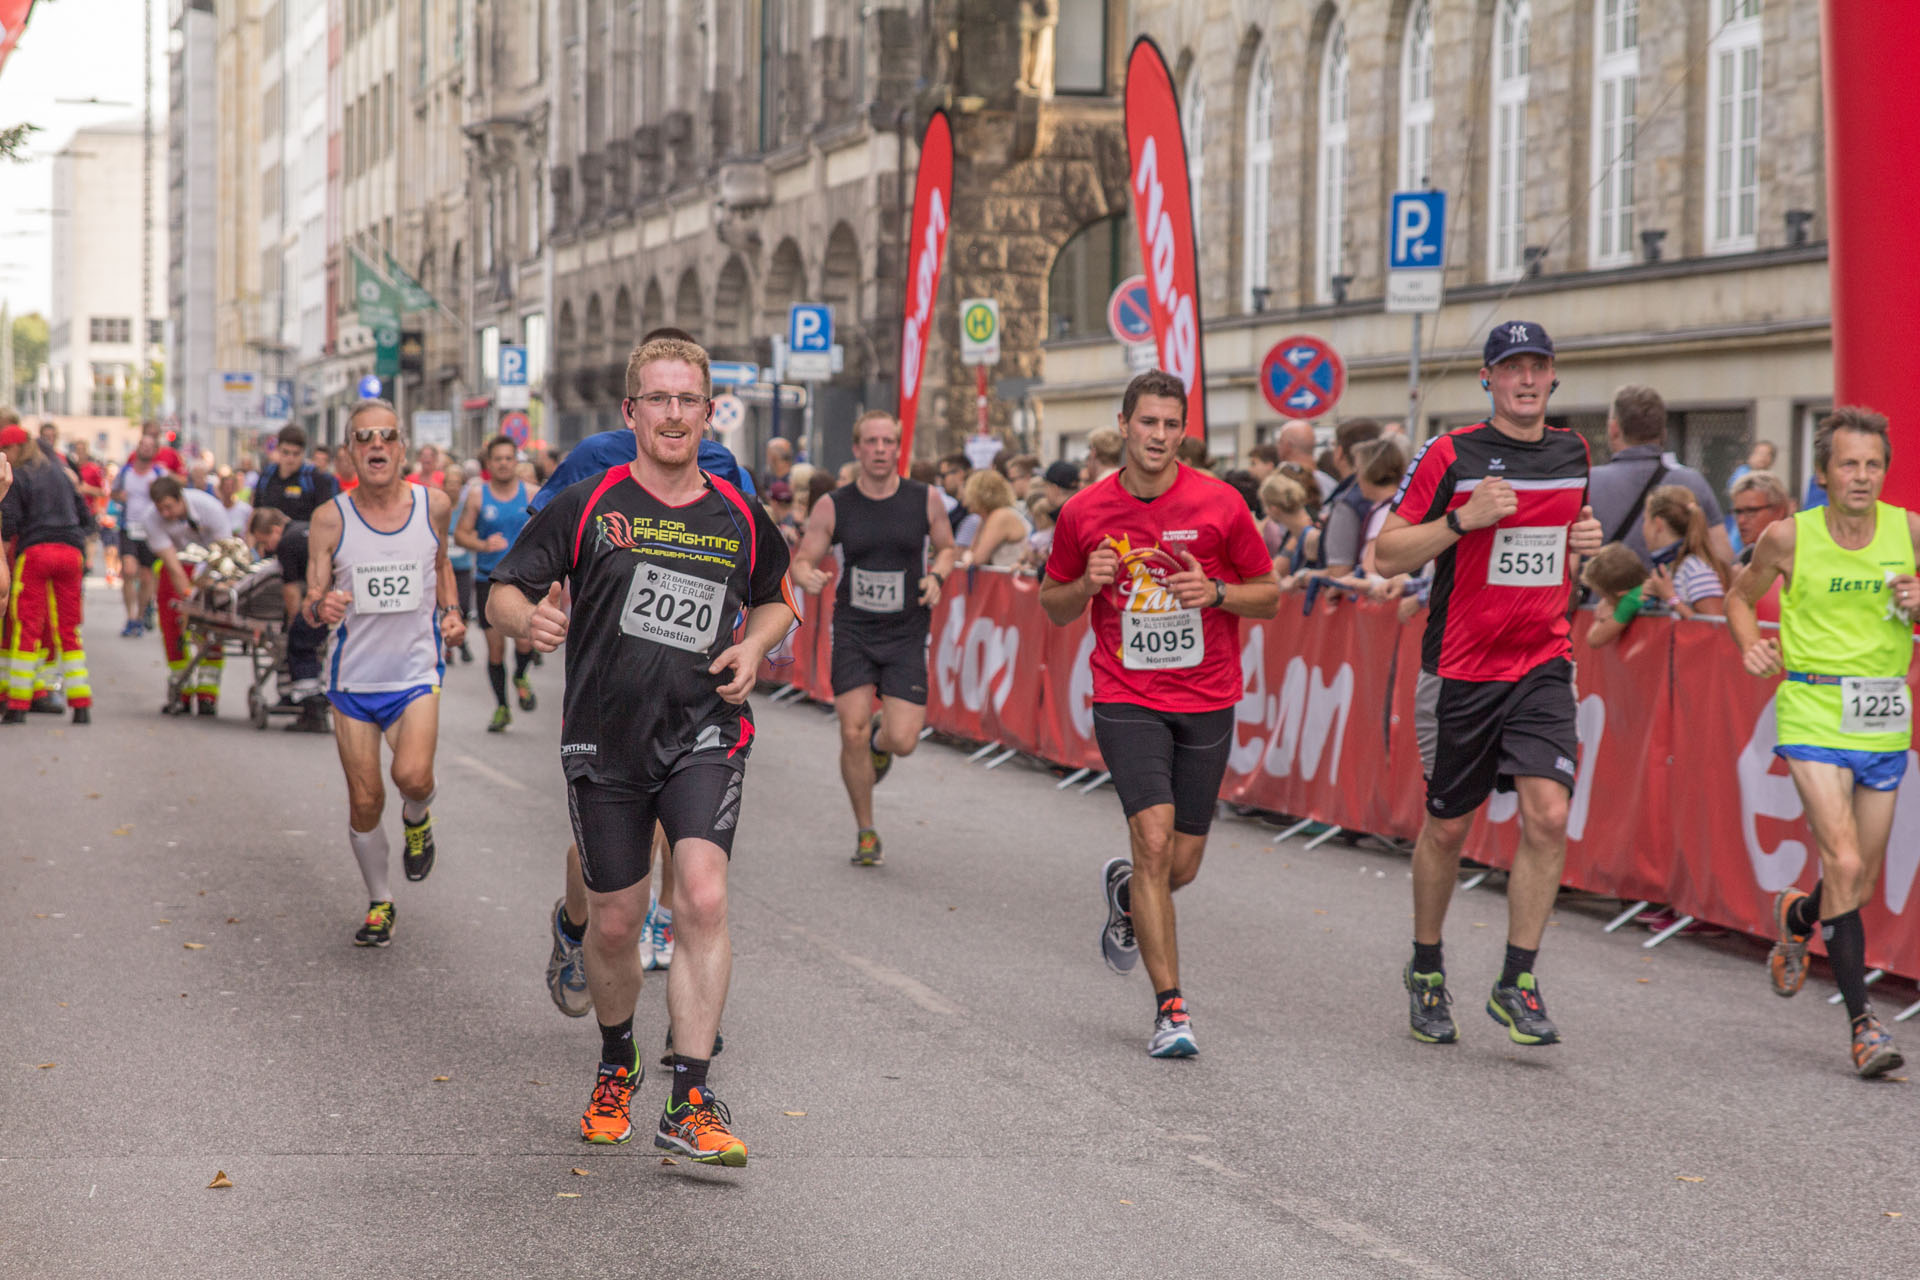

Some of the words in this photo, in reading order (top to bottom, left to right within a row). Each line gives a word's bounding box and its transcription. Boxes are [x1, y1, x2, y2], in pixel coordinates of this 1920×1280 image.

[1396, 201, 1431, 262] P
[796, 310, 821, 348] P
[974, 313, 986, 333] H
[503, 351, 522, 382] P
[634, 517, 653, 527] FIT
[660, 520, 685, 532] FOR
[633, 527, 740, 553] FIREFIGHTING
[1498, 552, 1555, 574] 5531
[368, 576, 410, 597] 652
[660, 581, 715, 602] ALSTERLAUF
[857, 581, 896, 600] 3471
[1829, 577, 1884, 594] Henry
[380, 600, 401, 608] M75
[632, 588, 712, 632] 2020
[642, 623, 697, 645] Sebastian
[1130, 628, 1195, 653] 4095
[1146, 655, 1182, 664] Norman
[1852, 696, 1905, 717] 1225
